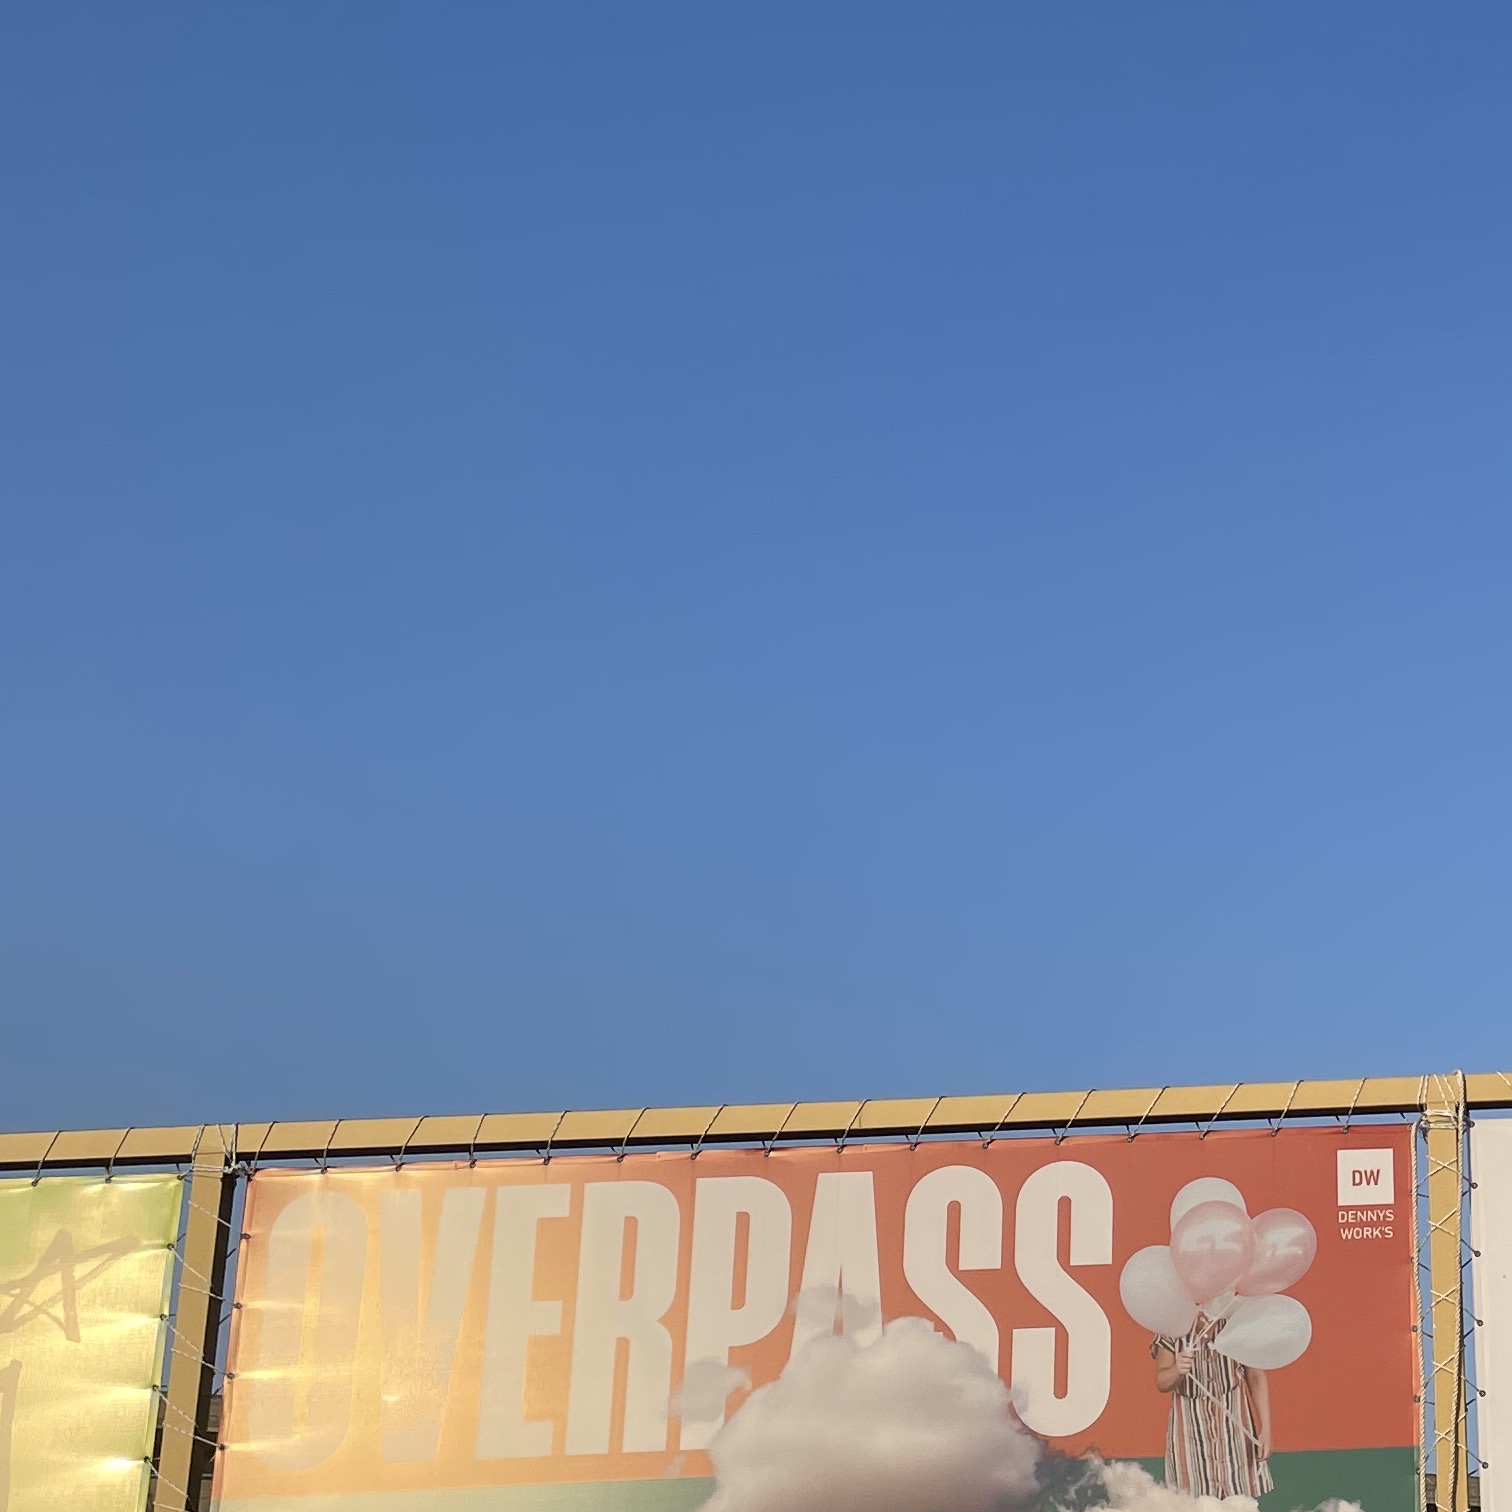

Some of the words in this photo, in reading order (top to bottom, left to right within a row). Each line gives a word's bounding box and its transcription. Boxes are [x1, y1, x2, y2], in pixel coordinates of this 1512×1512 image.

[1350, 1168, 1381, 1188] DW
[1337, 1209, 1396, 1225] DENNYS
[1339, 1225, 1395, 1241] WORK'S
[247, 1160, 1113, 1473] OVERPASS
